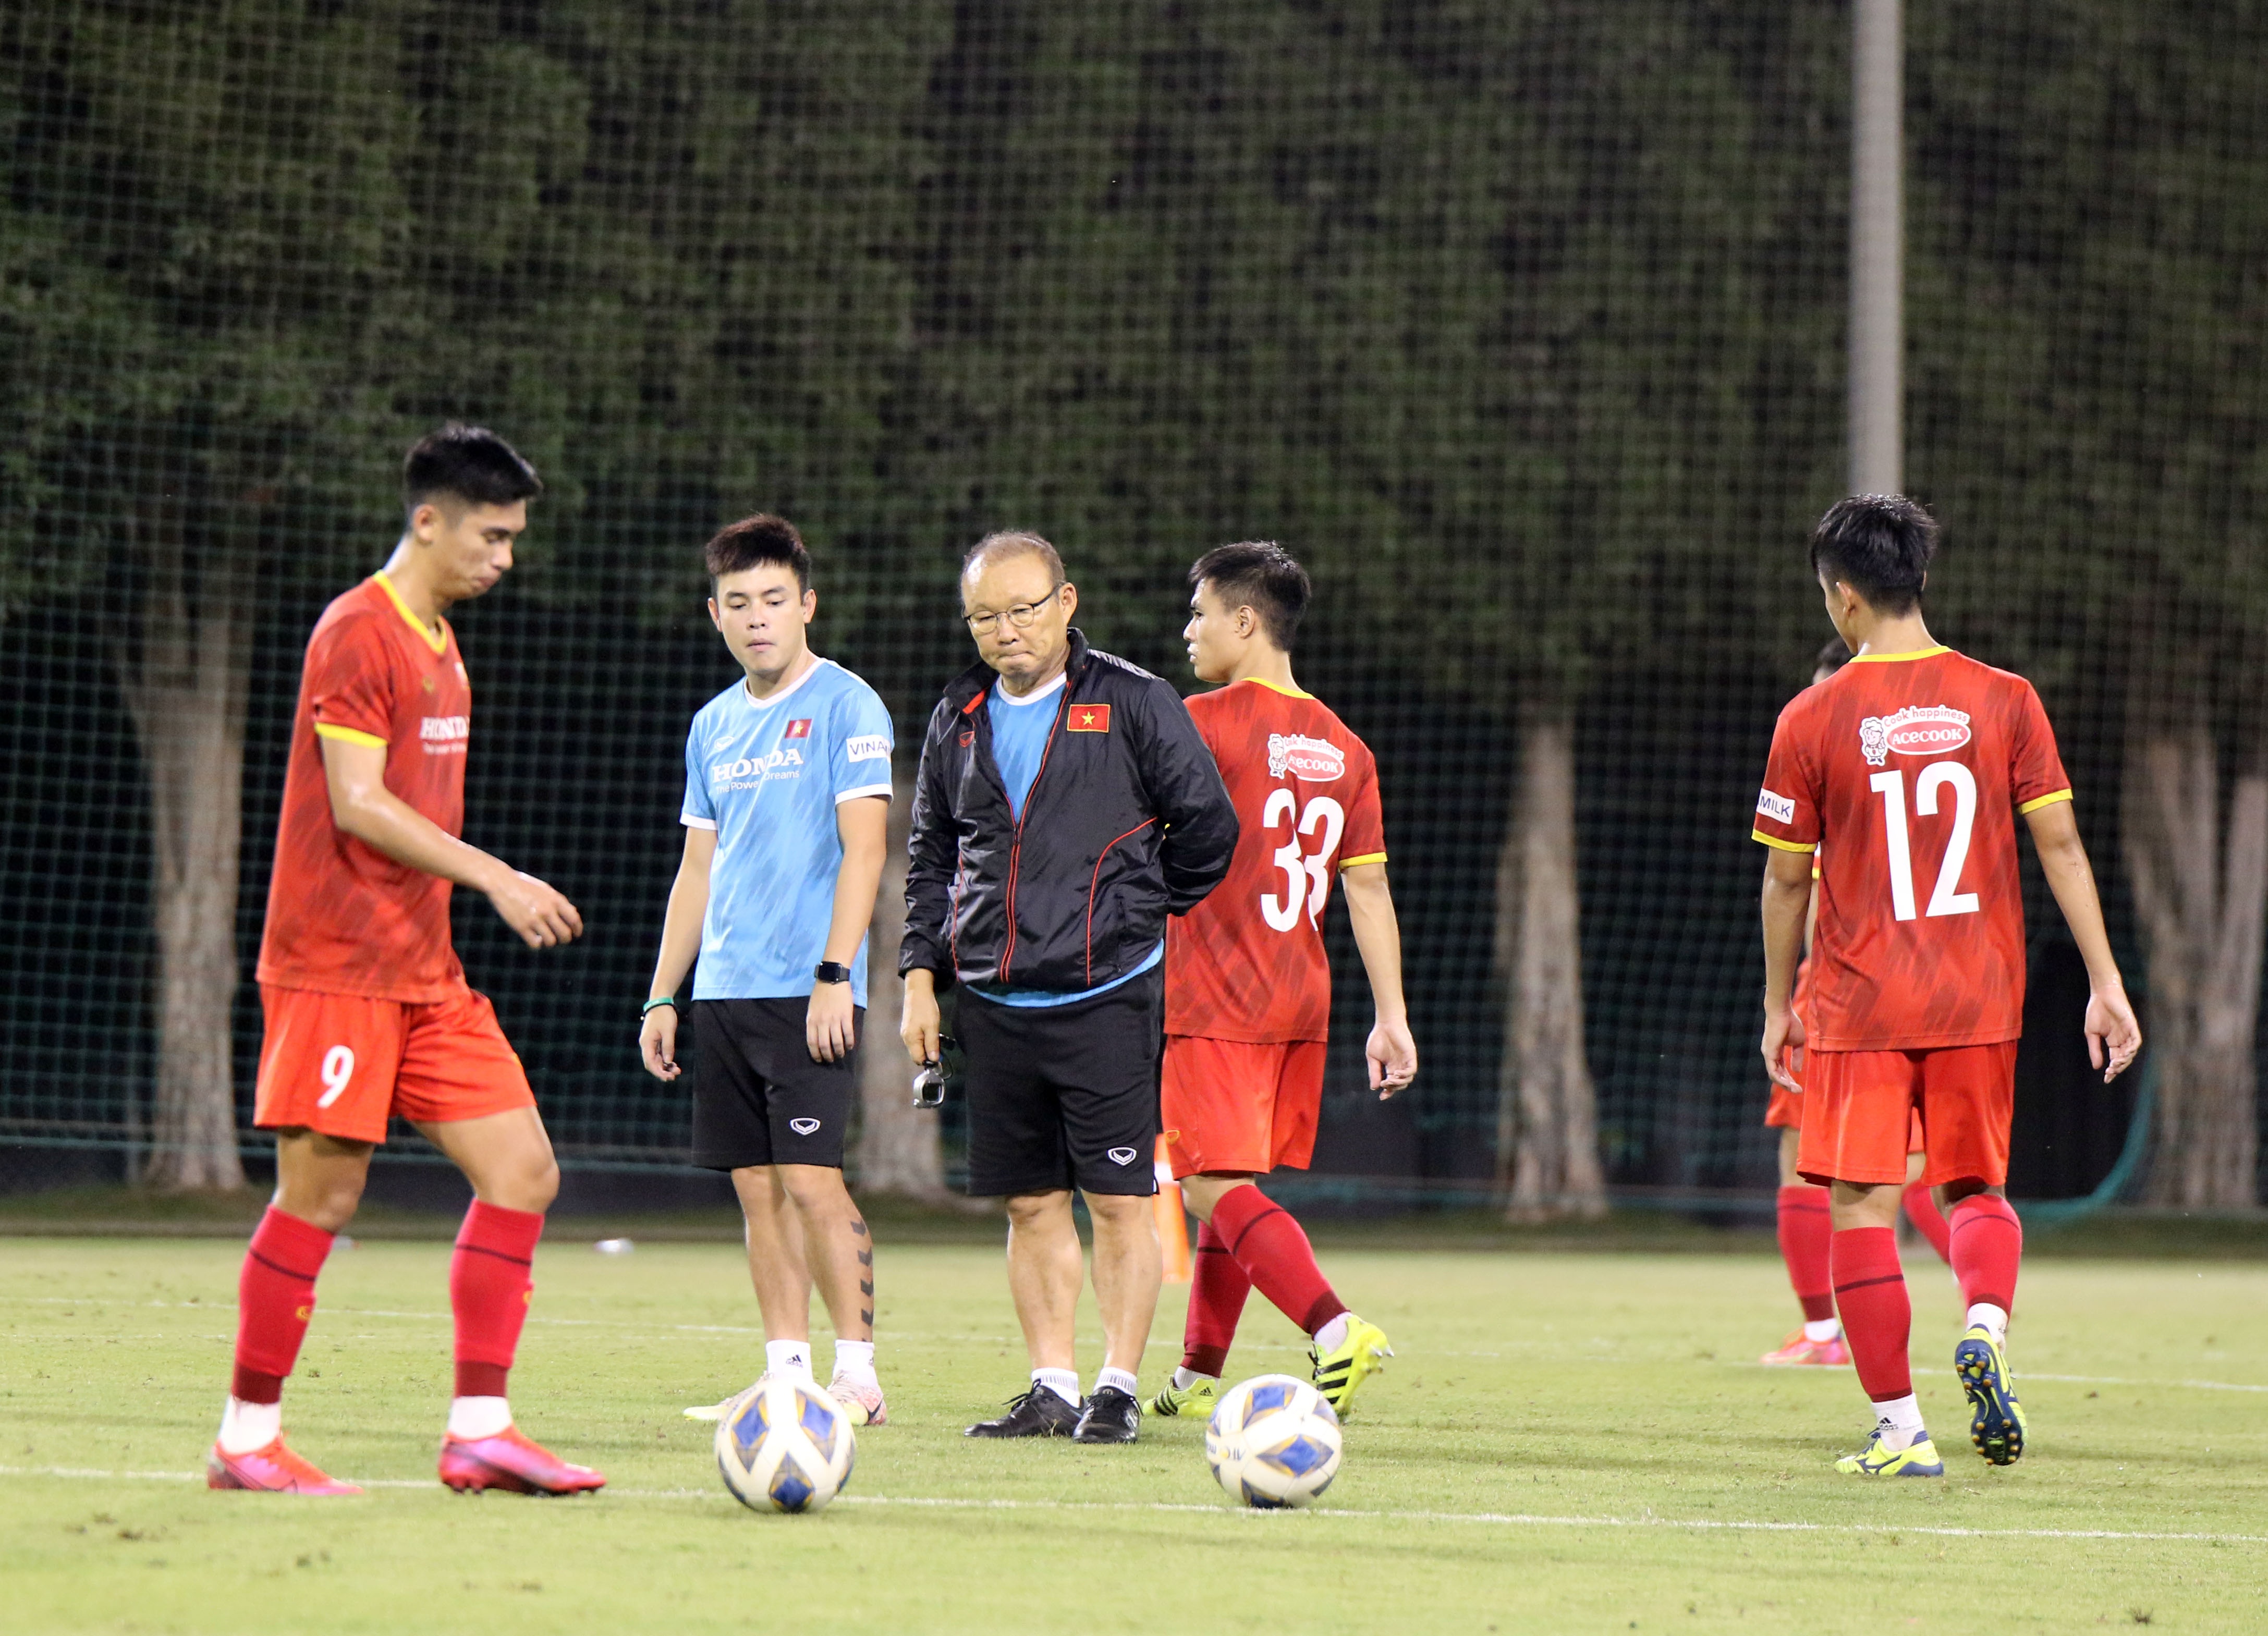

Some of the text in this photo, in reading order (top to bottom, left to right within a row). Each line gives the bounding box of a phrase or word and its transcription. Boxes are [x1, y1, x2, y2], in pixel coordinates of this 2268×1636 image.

[420, 715, 470, 741] HOND
[1884, 708, 1968, 727] Cook happiness
[1301, 737, 1342, 759] happiness
[712, 748, 804, 783] HONDA
[716, 770, 800, 795] The Powe Dreams
[1869, 761, 1980, 922] 12
[1260, 788, 1345, 932] 33
[316, 1044, 356, 1109] 9
